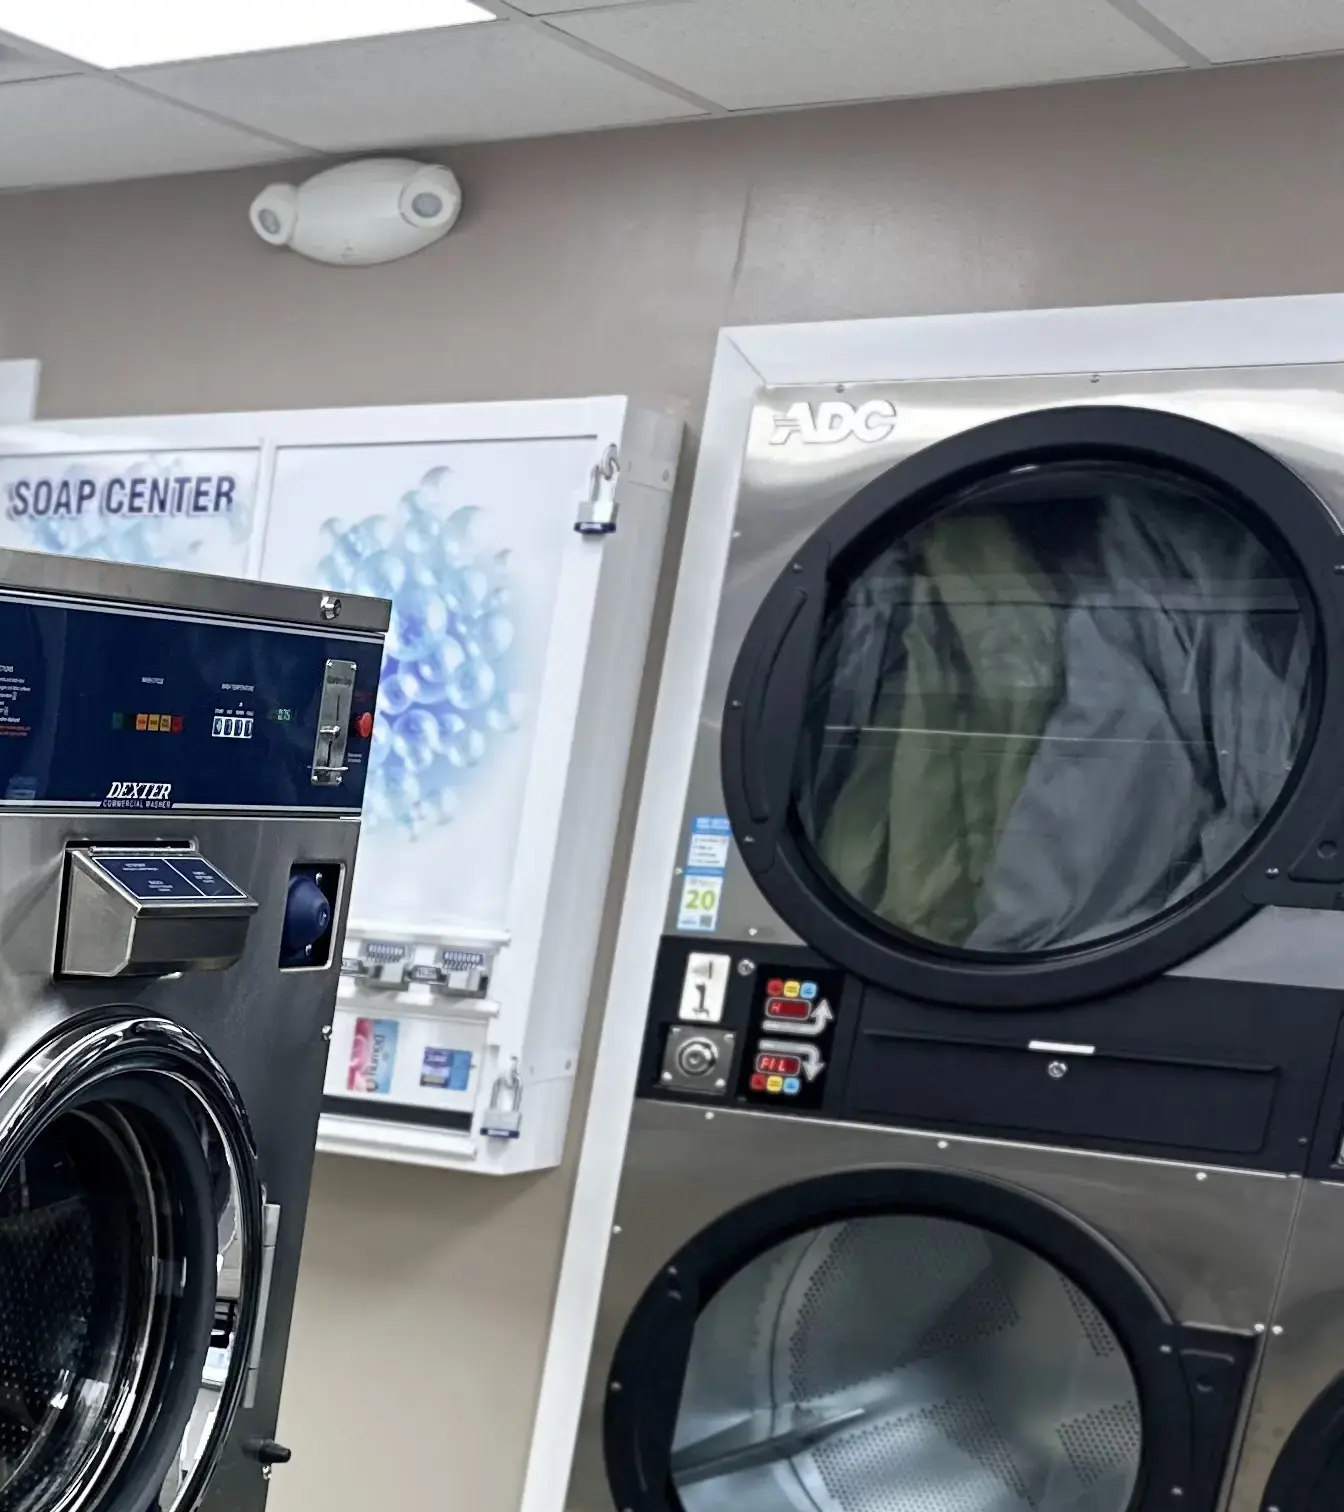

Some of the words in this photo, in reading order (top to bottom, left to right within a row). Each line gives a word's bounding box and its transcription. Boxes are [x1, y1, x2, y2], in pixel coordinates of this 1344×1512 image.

[769, 400, 897, 445] ADC
[12, 479, 97, 516] SOAP
[105, 476, 236, 514] CENTER
[106, 782, 172, 799] DEXTER
[102, 800, 142, 808] COMMERCIAL
[685, 889, 716, 911] 20
